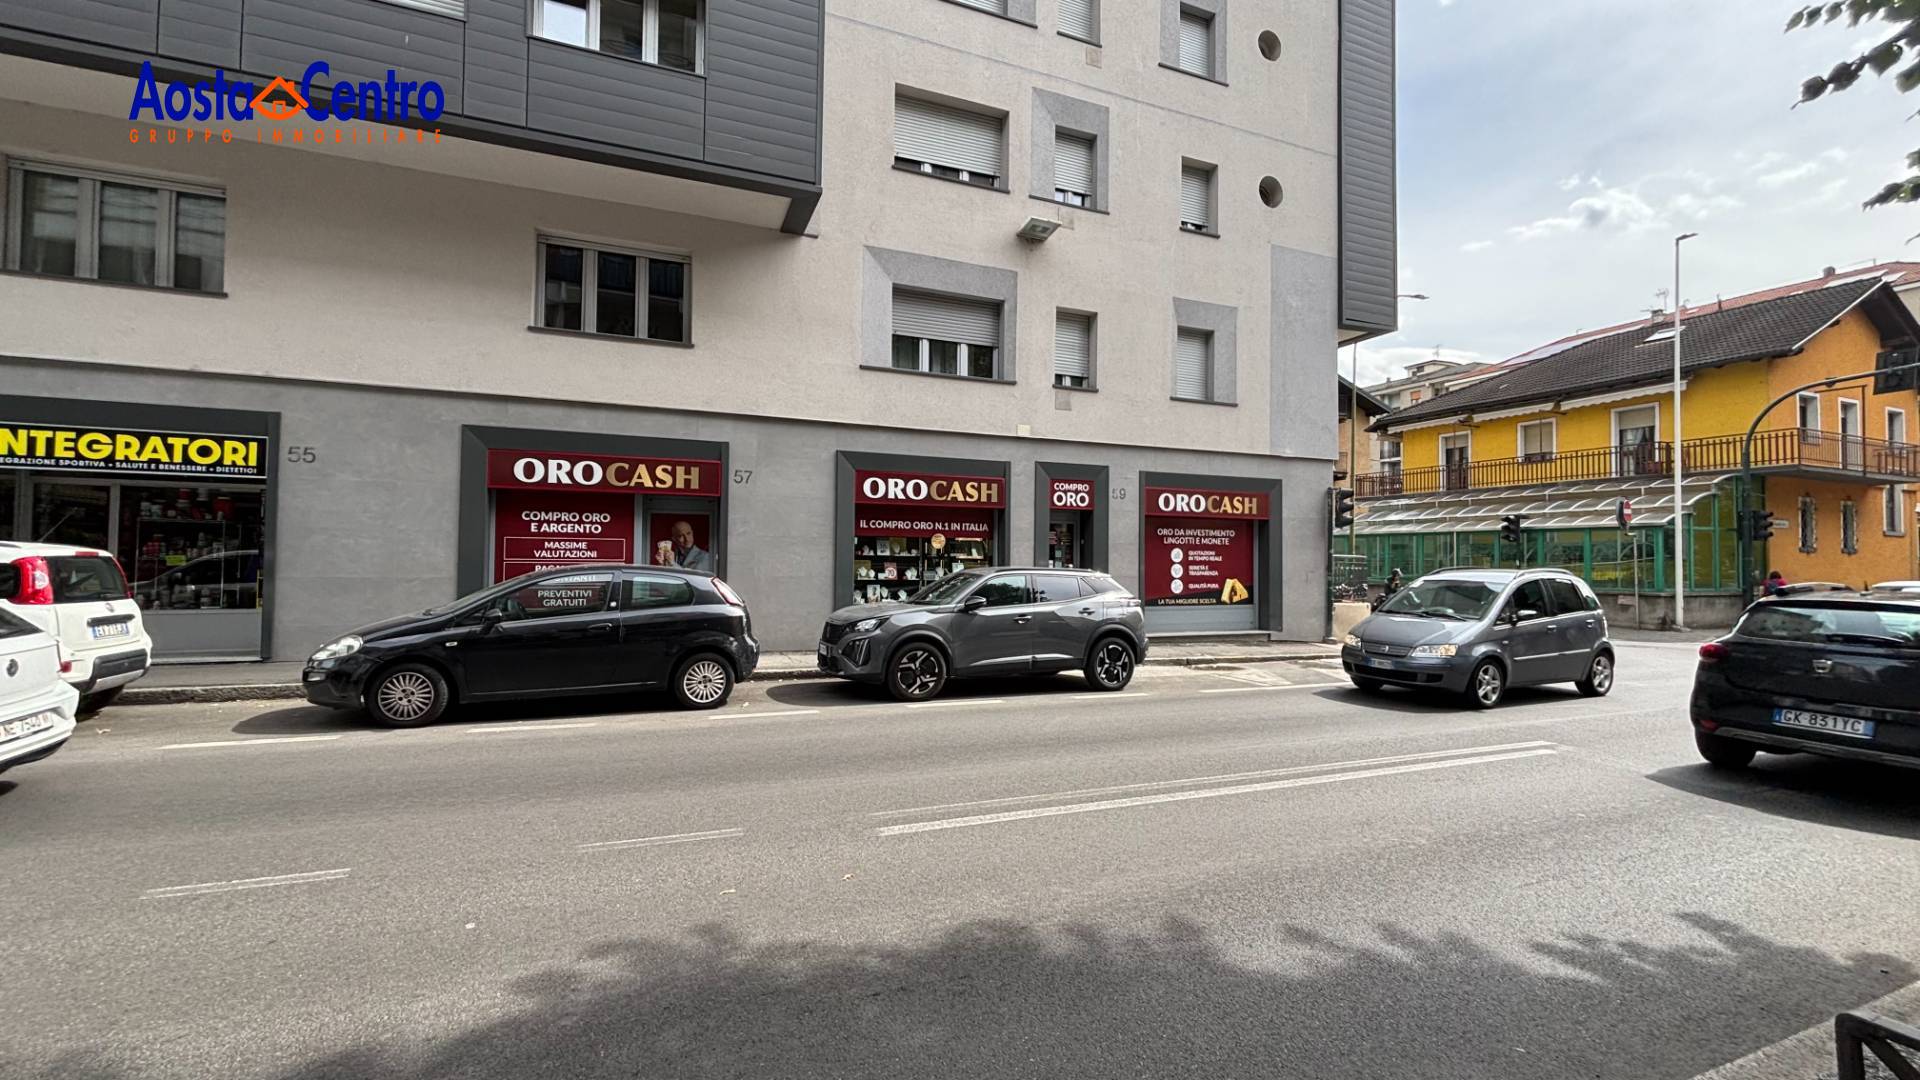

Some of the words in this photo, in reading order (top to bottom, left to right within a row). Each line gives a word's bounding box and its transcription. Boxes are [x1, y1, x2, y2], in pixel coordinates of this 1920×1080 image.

[287, 446, 317, 464] 55
[59, 459, 106, 468] SPORTIVA
[115, 461, 148, 470] SALUTE
[158, 463, 207, 473] BENESSERE
[215, 466, 258, 475] DIETETICI
[512, 457, 700, 490] OROCASH
[733, 469, 753, 484] 57
[862, 476, 999, 503] OROCASH
[1053, 482, 1090, 492] COMPRO
[1111, 487, 1127, 500] 59
[1053, 491, 1090, 507] ORO
[1157, 492, 1258, 515] OROCASH
[521, 510, 580, 522] COMPRO
[582, 512, 611, 523] ORO
[530, 522, 539, 532] E
[540, 522, 602, 534] ARGENTO
[859, 519, 869, 529] IL
[869, 520, 911, 531] COMPRO
[913, 520, 933, 531] ORO
[934, 521, 949, 531] N.1
[951, 522, 961, 532] IN
[961, 522, 989, 533] ITALIA
[1157, 528, 1174, 536] ORO
[1174, 528, 1185, 536] DA
[1185, 529, 1236, 538] INVESTIMENTO
[544, 541, 588, 550] MASSIME
[1163, 537, 1195, 545] LINGOTTI
[1201, 537, 1230, 545] MONETE
[533, 549, 598, 559] VALUTAZIONI
[537, 589, 593, 598] PREVENTIVI
[543, 599, 587, 607] GRATUITI
[1783, 709, 1803, 724] GK
